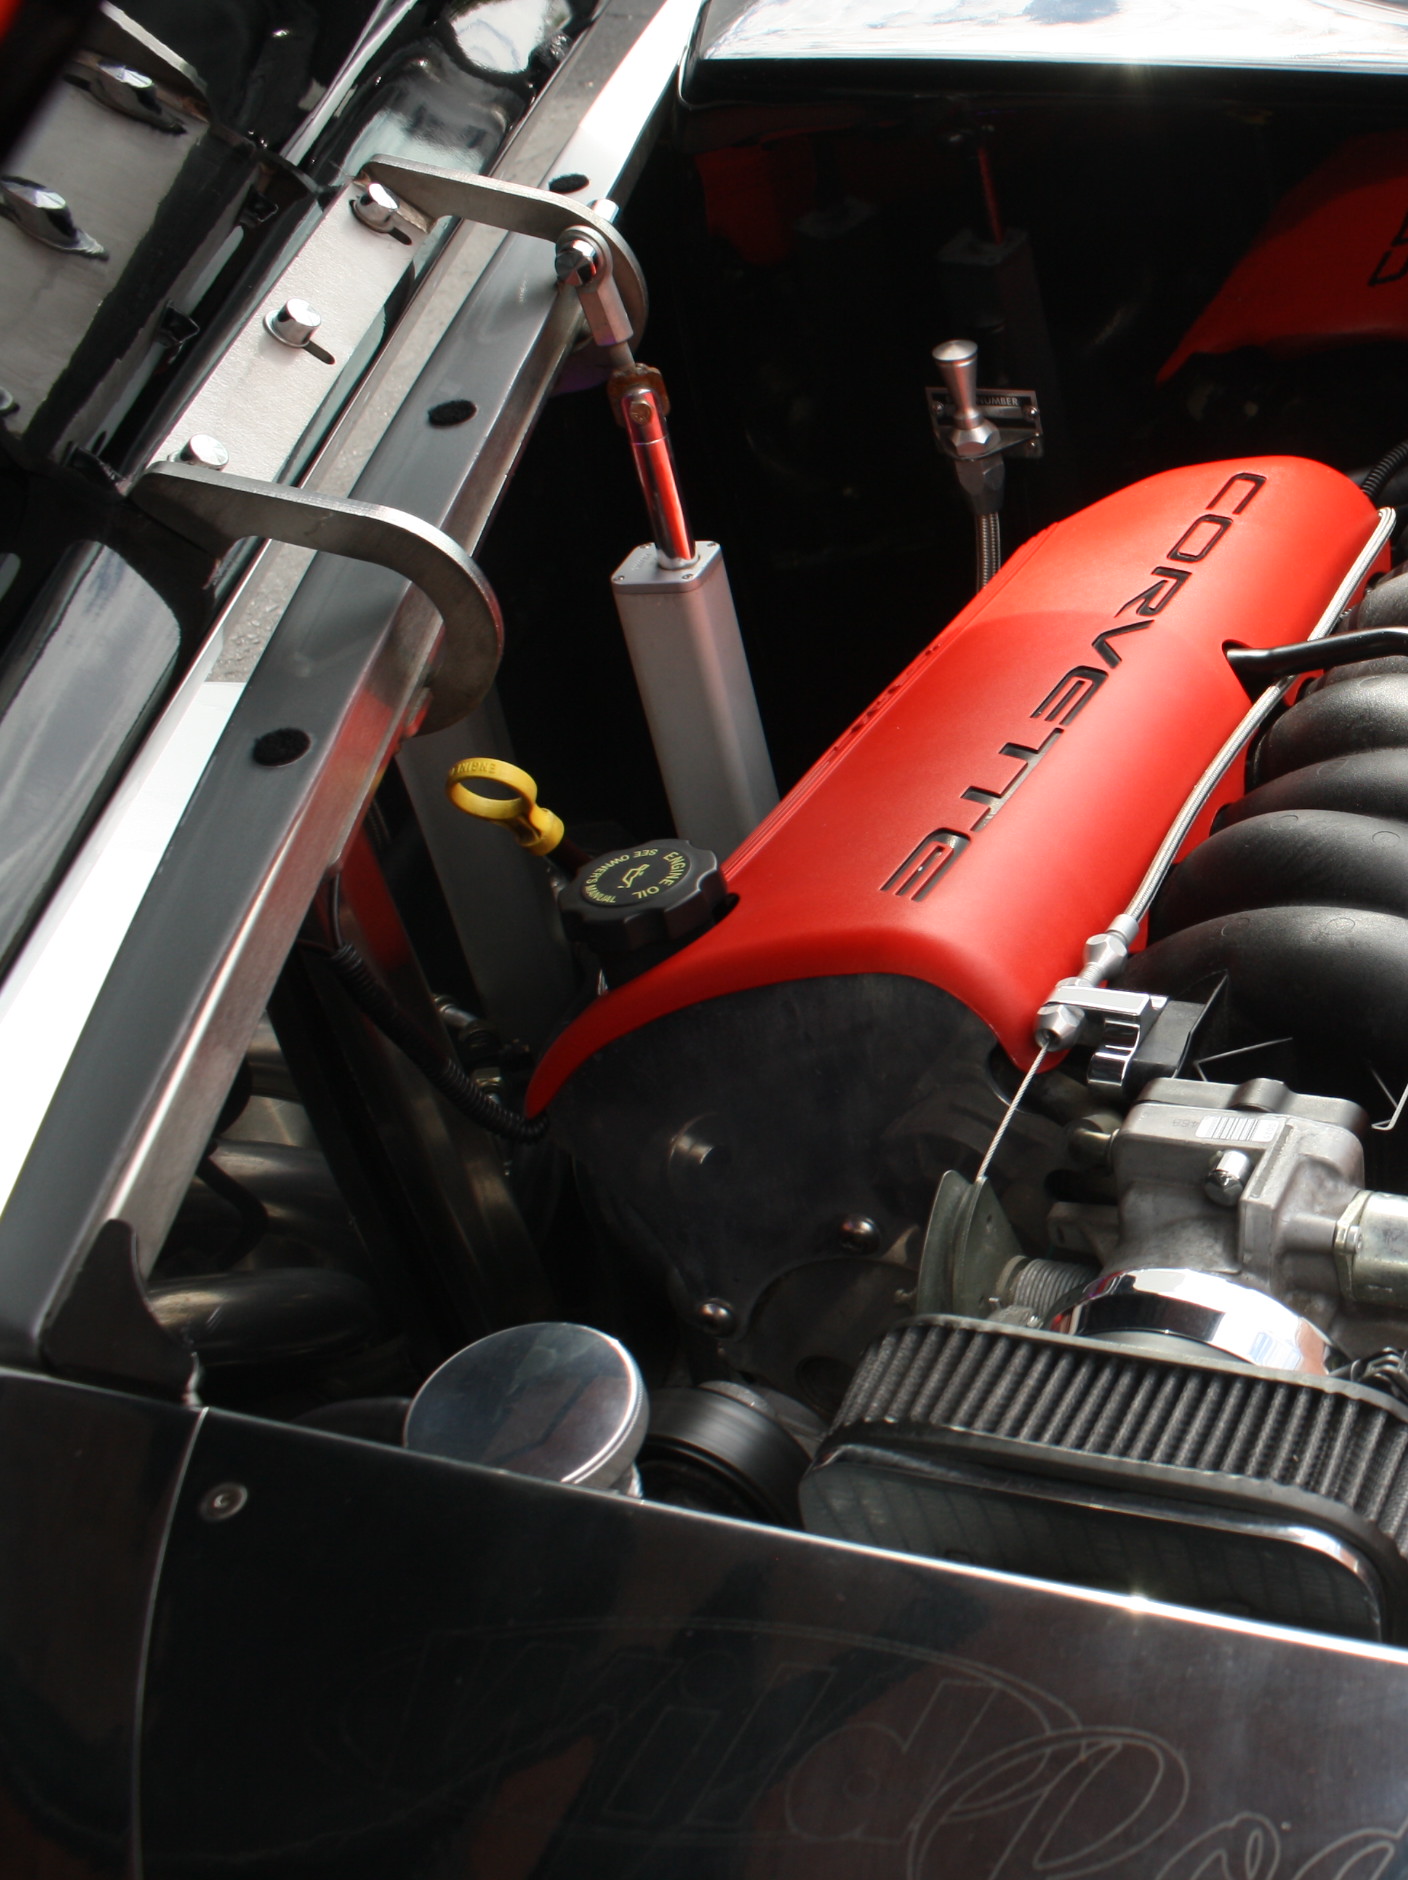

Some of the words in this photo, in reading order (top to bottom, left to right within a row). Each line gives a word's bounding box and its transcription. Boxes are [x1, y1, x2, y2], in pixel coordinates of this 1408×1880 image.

[880, 471, 1266, 901] CORVETTE
[633, 849, 658, 858] SEE
[659, 851, 686, 886] ENGINE
[585, 886, 616, 903] MANUAL
[632, 886, 659, 899] OIL
